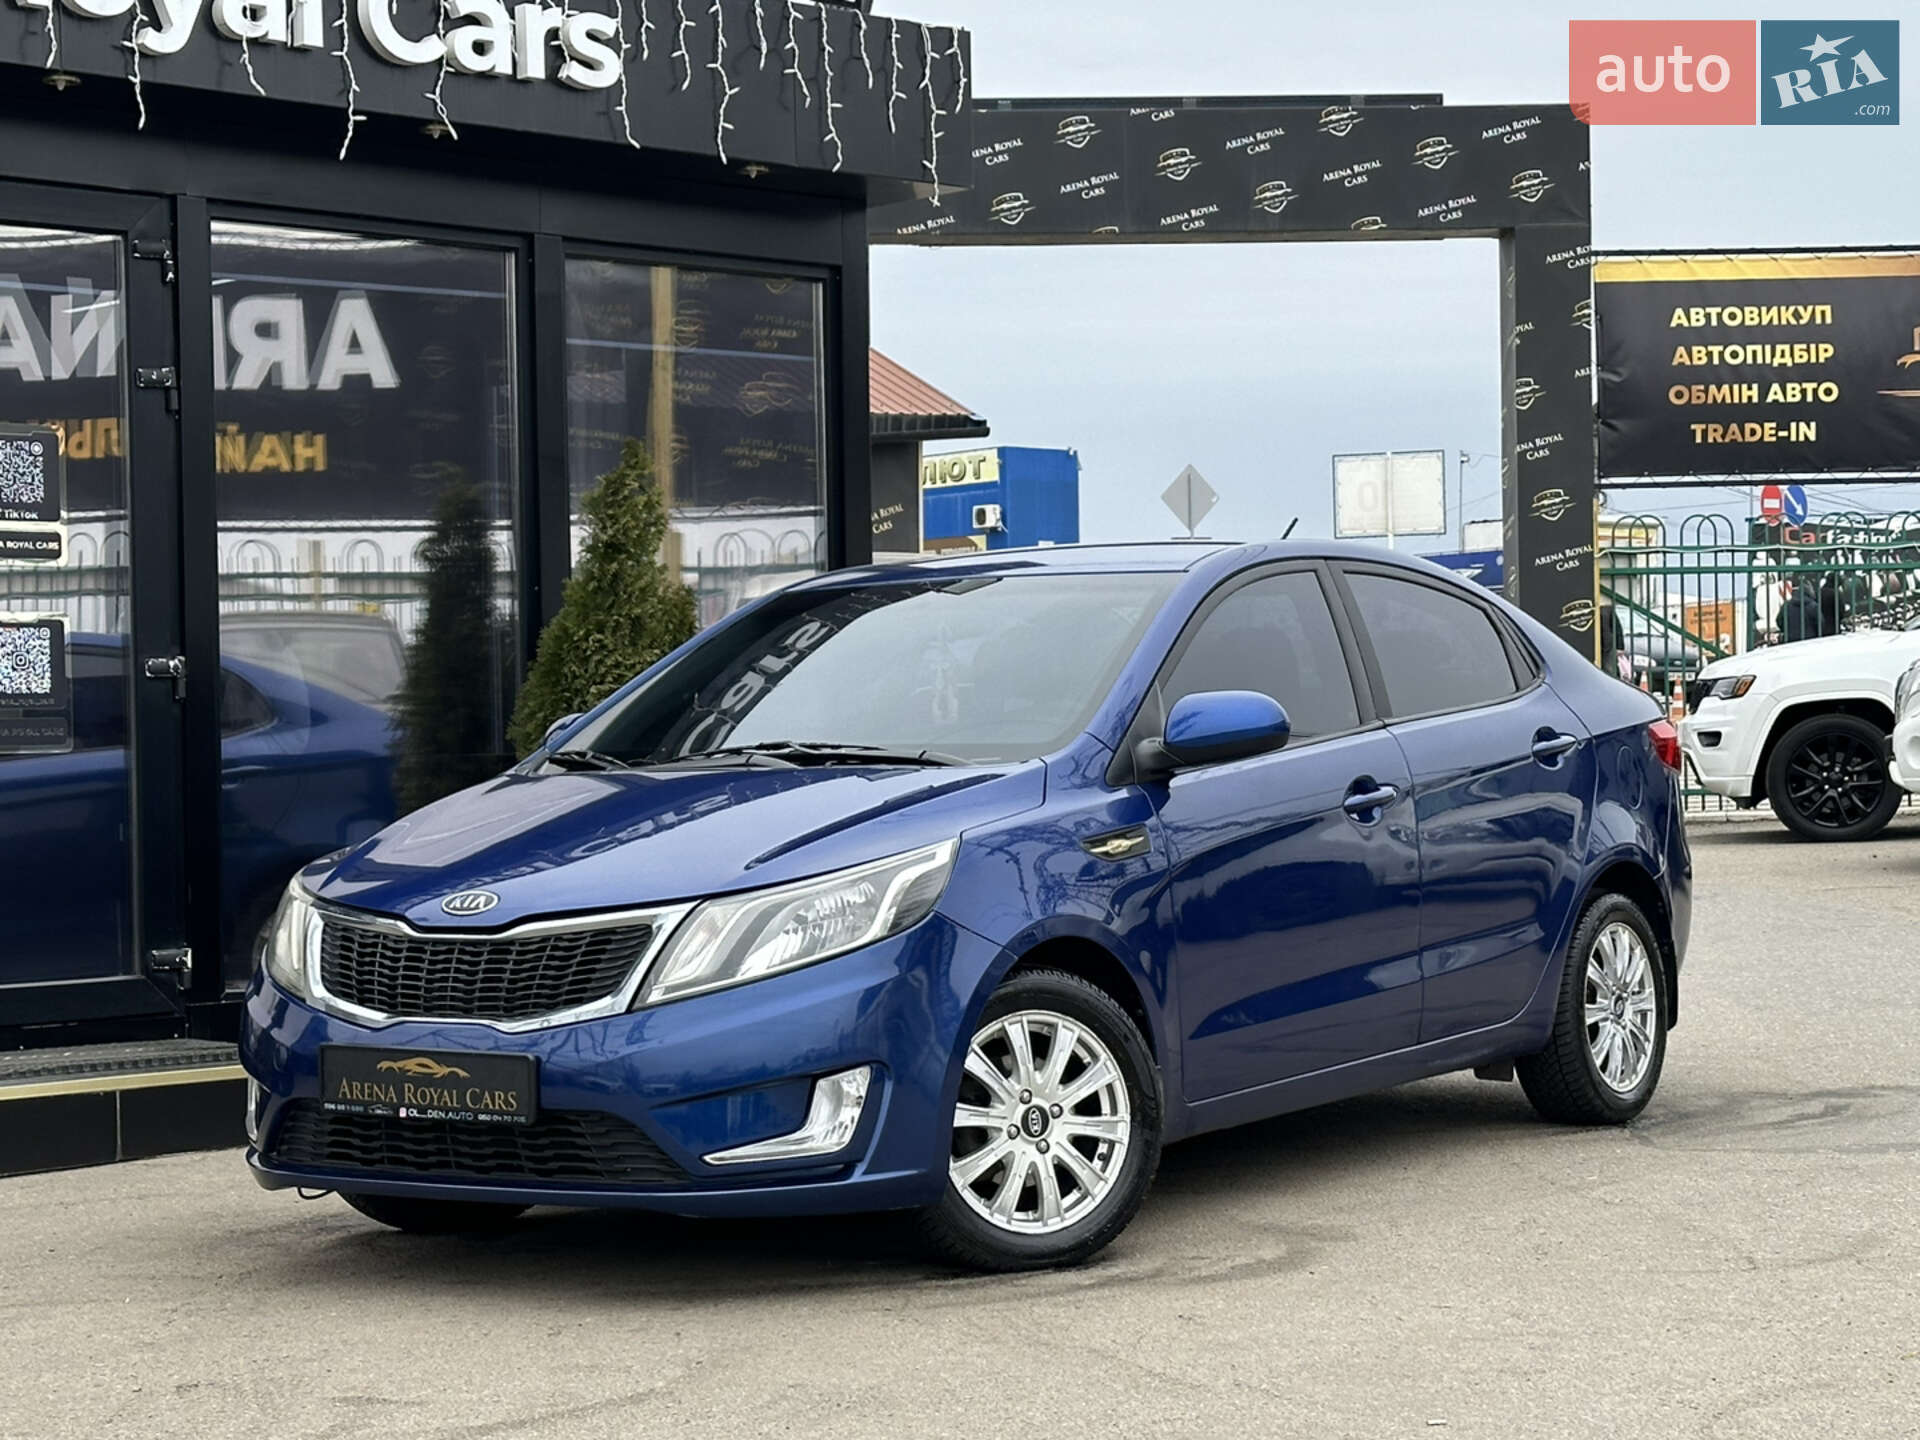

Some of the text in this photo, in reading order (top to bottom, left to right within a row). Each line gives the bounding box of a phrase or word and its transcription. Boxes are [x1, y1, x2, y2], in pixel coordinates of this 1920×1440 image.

[357, 0, 622, 90] Cars
[1481, 116, 1542, 139] ARENA ROYAL
[994, 138, 1023, 152] ROYAL
[1225, 127, 1285, 150] ARENA ROYAL
[1504, 132, 1527, 144] CARS
[1247, 142, 1271, 155] CARS
[985, 153, 1009, 166] CARS
[1322, 160, 1383, 182] ARENA ROYAL
[1060, 172, 1119, 194] ARENA ROYAL
[1344, 174, 1368, 187] CARS
[1081, 187, 1106, 199] CARS
[1417, 195, 1477, 218] ARENA ROYAL
[927, 215, 956, 229] ROYAL
[1160, 204, 1219, 226] ARENA ROYAL
[1439, 210, 1463, 222] CARS
[1182, 219, 1206, 232] CARS
[1545, 250, 1575, 264] ARENA
[1669, 304, 1833, 328] АВТОВИКУП
[1671, 343, 1836, 367] АВТОПІДБІР
[1668, 381, 1839, 405] ОБМІН АВТО
[1690, 421, 1817, 444] TRADE-IN
[1535, 433, 1564, 448] ROYAL
[1526, 447, 1550, 461] CARS
[879, 503, 904, 518] ROYAL
[1534, 543, 1594, 567] ARENA ROYAL
[1556, 559, 1580, 573] CARS
[449, 895, 488, 909] KIA
[338, 1077, 517, 1112] ARENA ROYAL CARS
